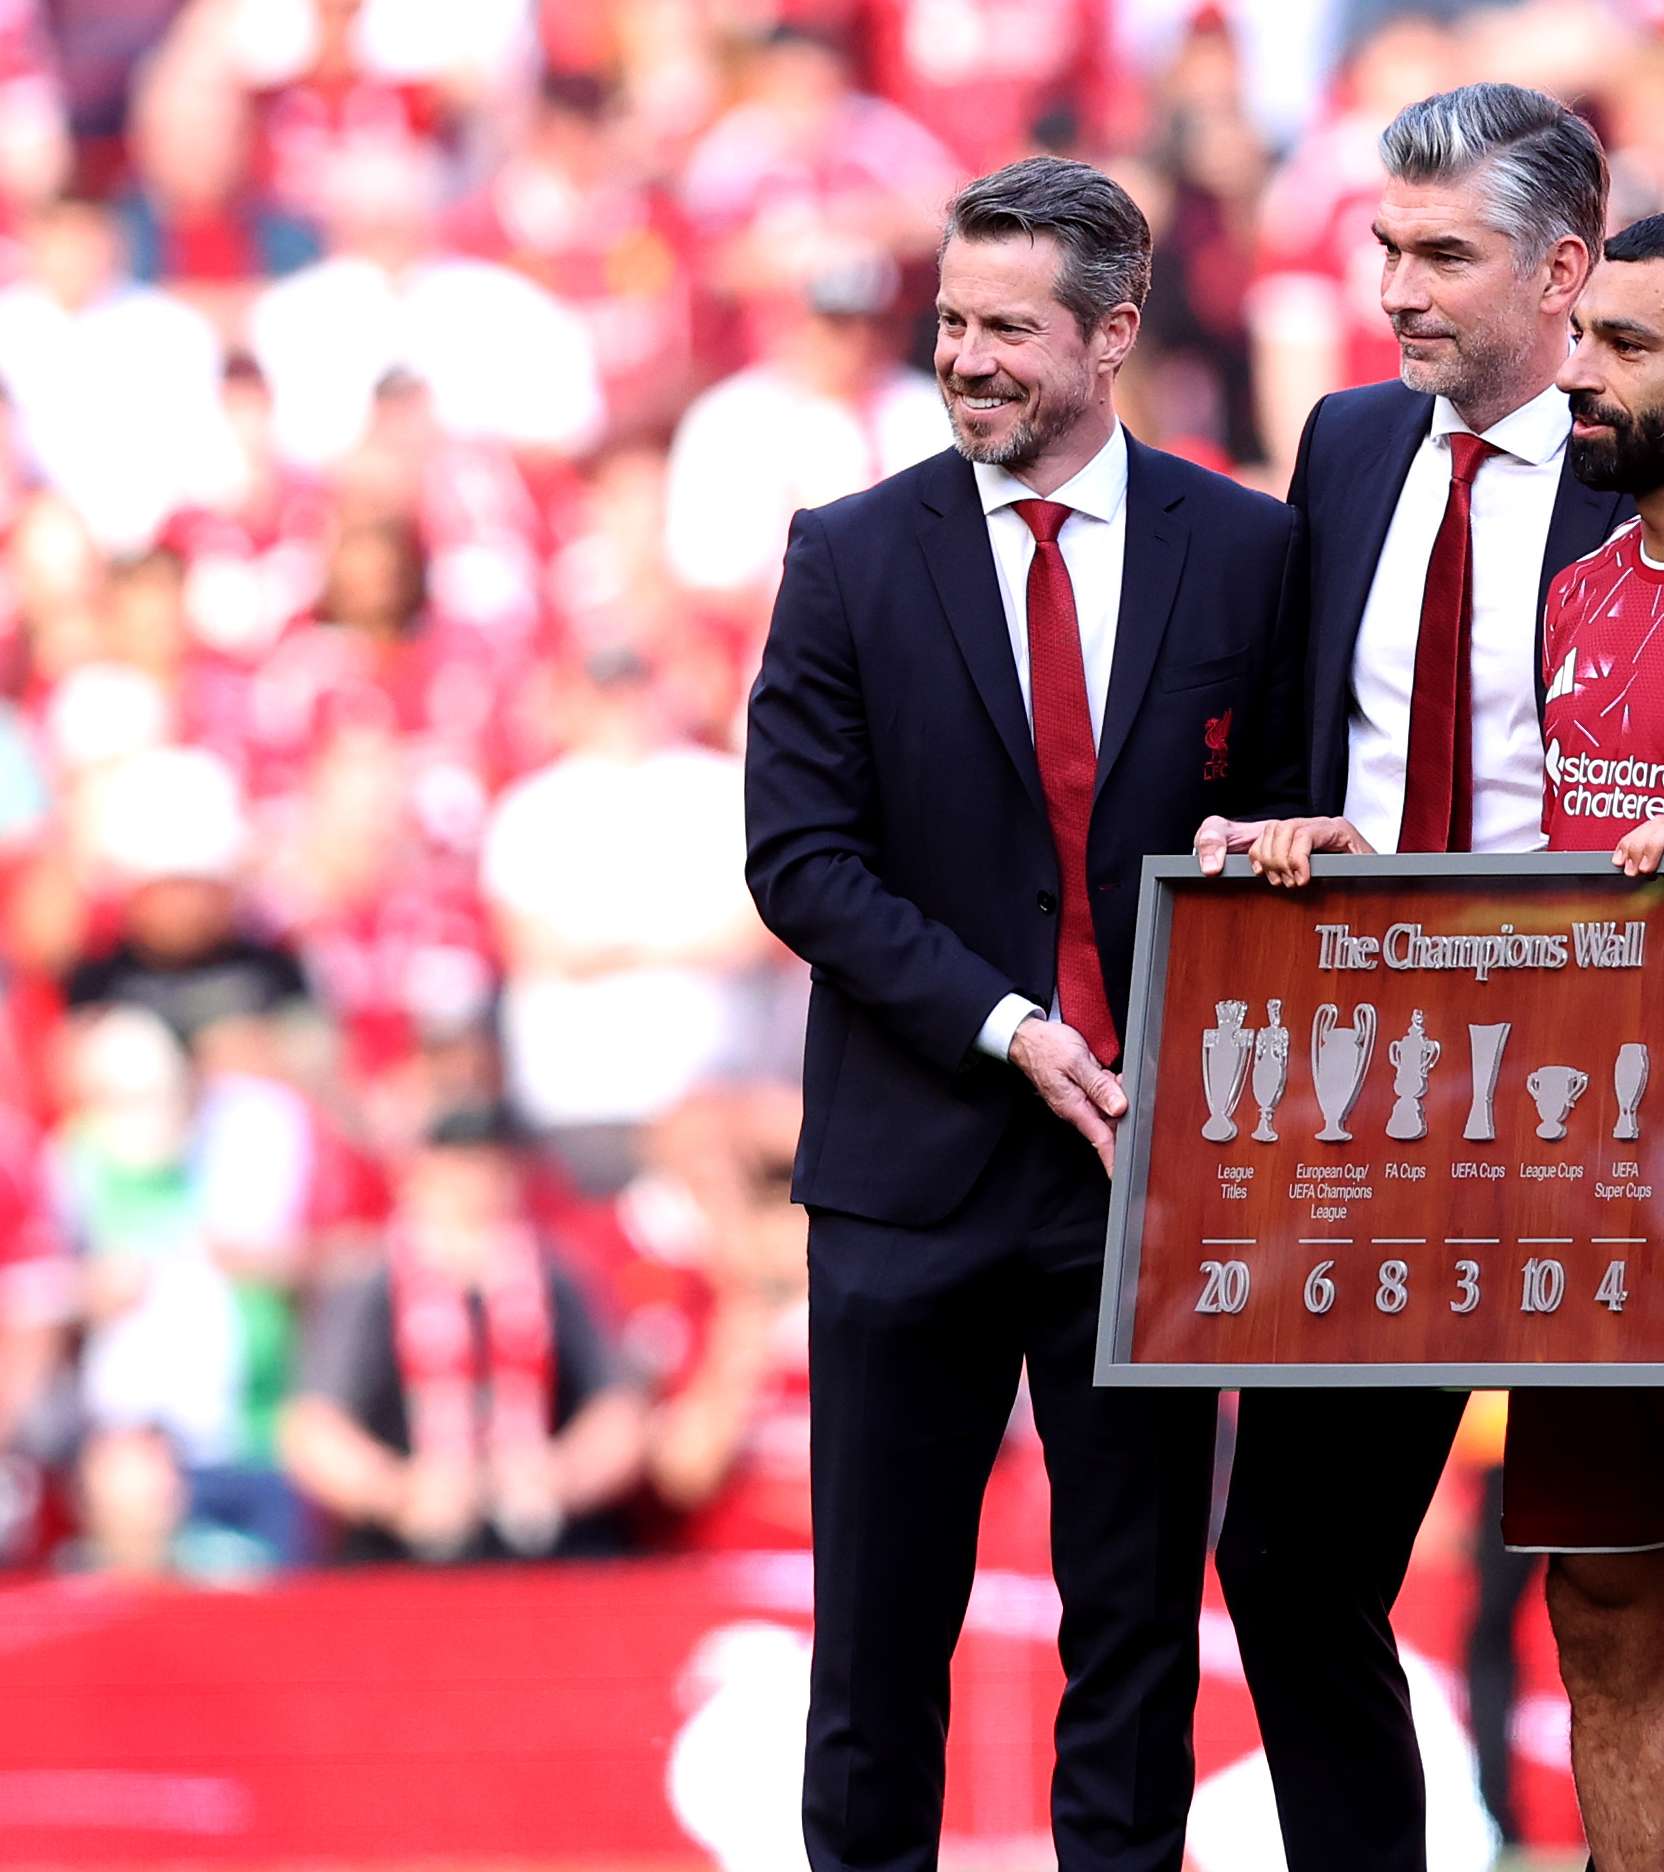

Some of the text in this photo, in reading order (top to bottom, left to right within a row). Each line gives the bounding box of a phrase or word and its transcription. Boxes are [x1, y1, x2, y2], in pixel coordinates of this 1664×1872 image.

[1314, 921, 1646, 981] The Champions Wall
[1217, 1163, 1255, 1183] League
[1296, 1162, 1370, 1182] European Cup/
[1385, 1162, 1427, 1182] FA Cups
[1451, 1162, 1506, 1182] UEFA Cups
[1519, 1162, 1584, 1182] League Cups
[1612, 1161, 1640, 1178] UEFA
[1220, 1183, 1248, 1200] Titles
[1288, 1182, 1373, 1202] UEFA Champions
[1594, 1182, 1652, 1202] Super Cups
[1310, 1203, 1348, 1223] League
[1194, 1260, 1250, 1314] 20
[1303, 1260, 1336, 1314] 6
[1375, 1259, 1409, 1314] 8
[1449, 1259, 1481, 1313] 3
[1519, 1257, 1565, 1313] 10
[1593, 1259, 1629, 1312] 4
